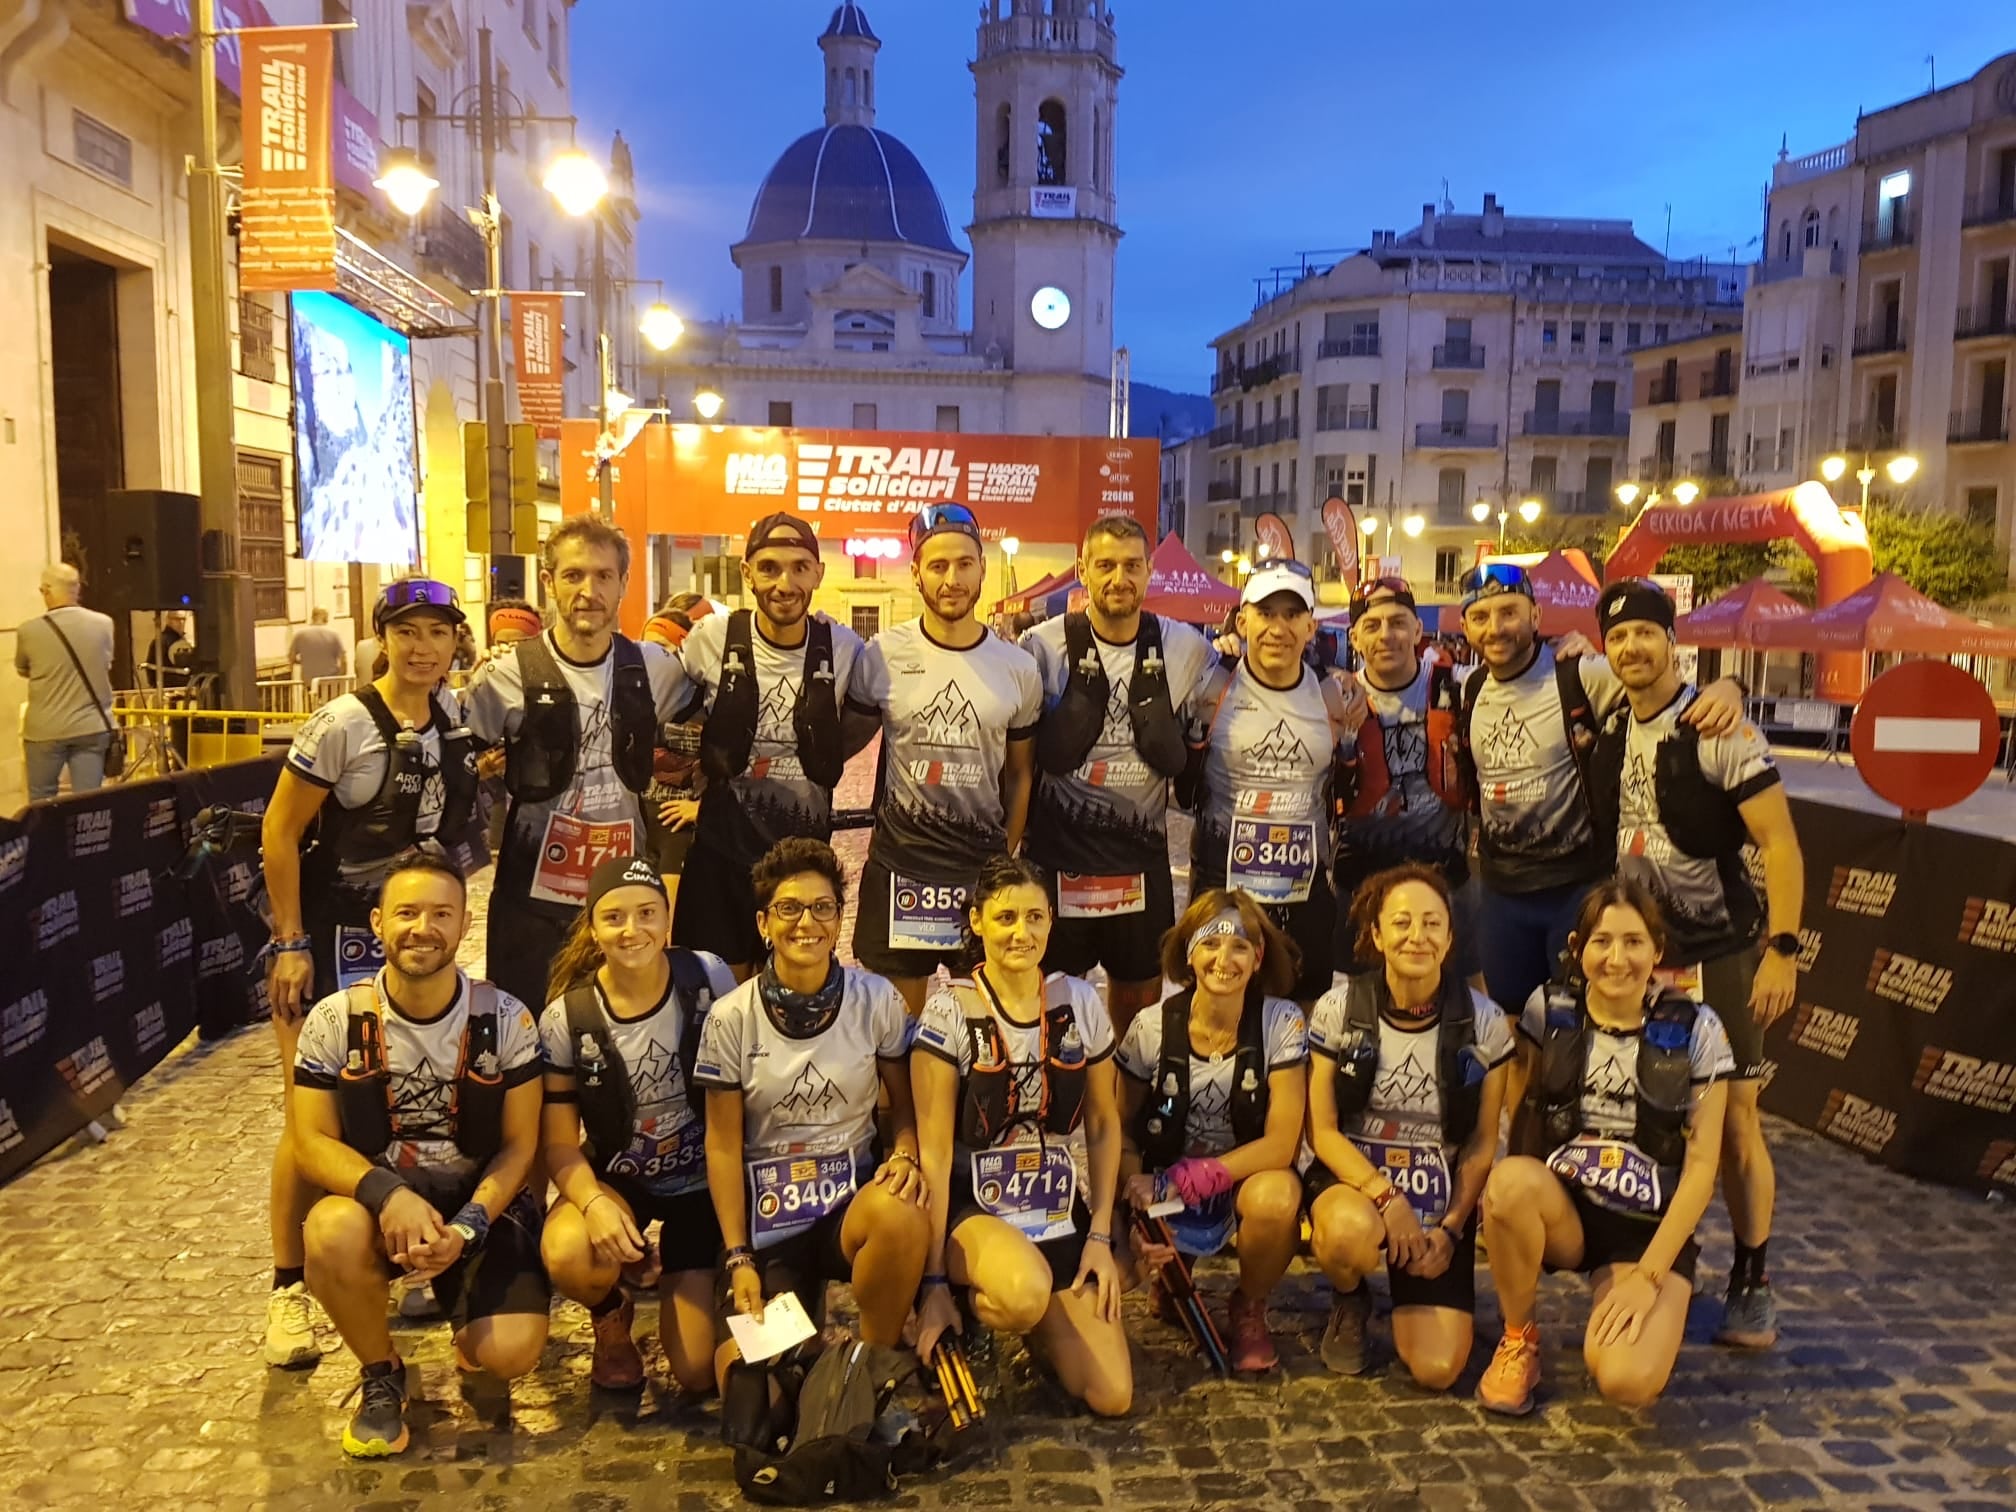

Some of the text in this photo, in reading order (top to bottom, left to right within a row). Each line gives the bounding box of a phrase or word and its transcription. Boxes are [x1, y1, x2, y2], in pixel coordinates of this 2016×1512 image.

[261, 58, 283, 146] TRAIL
[835, 445, 960, 478] TRAIL
[987, 463, 1040, 476] MARXA
[827, 474, 958, 499] solidari
[986, 474, 1037, 486] TRAIL
[824, 498, 883, 513] Ciutat
[1723, 502, 1776, 530] META
[909, 760, 930, 782] 10
[1236, 790, 1258, 808] 10
[1258, 842, 1310, 866] 3404
[1846, 867, 1897, 890] TRAIL
[1887, 952, 1952, 988] TRAIL
[1811, 1005, 1860, 1032] TRAIL
[1842, 1093, 1898, 1126] TRAIL
[783, 1178, 848, 1211] 3402
[1006, 1170, 1068, 1198] 4714
